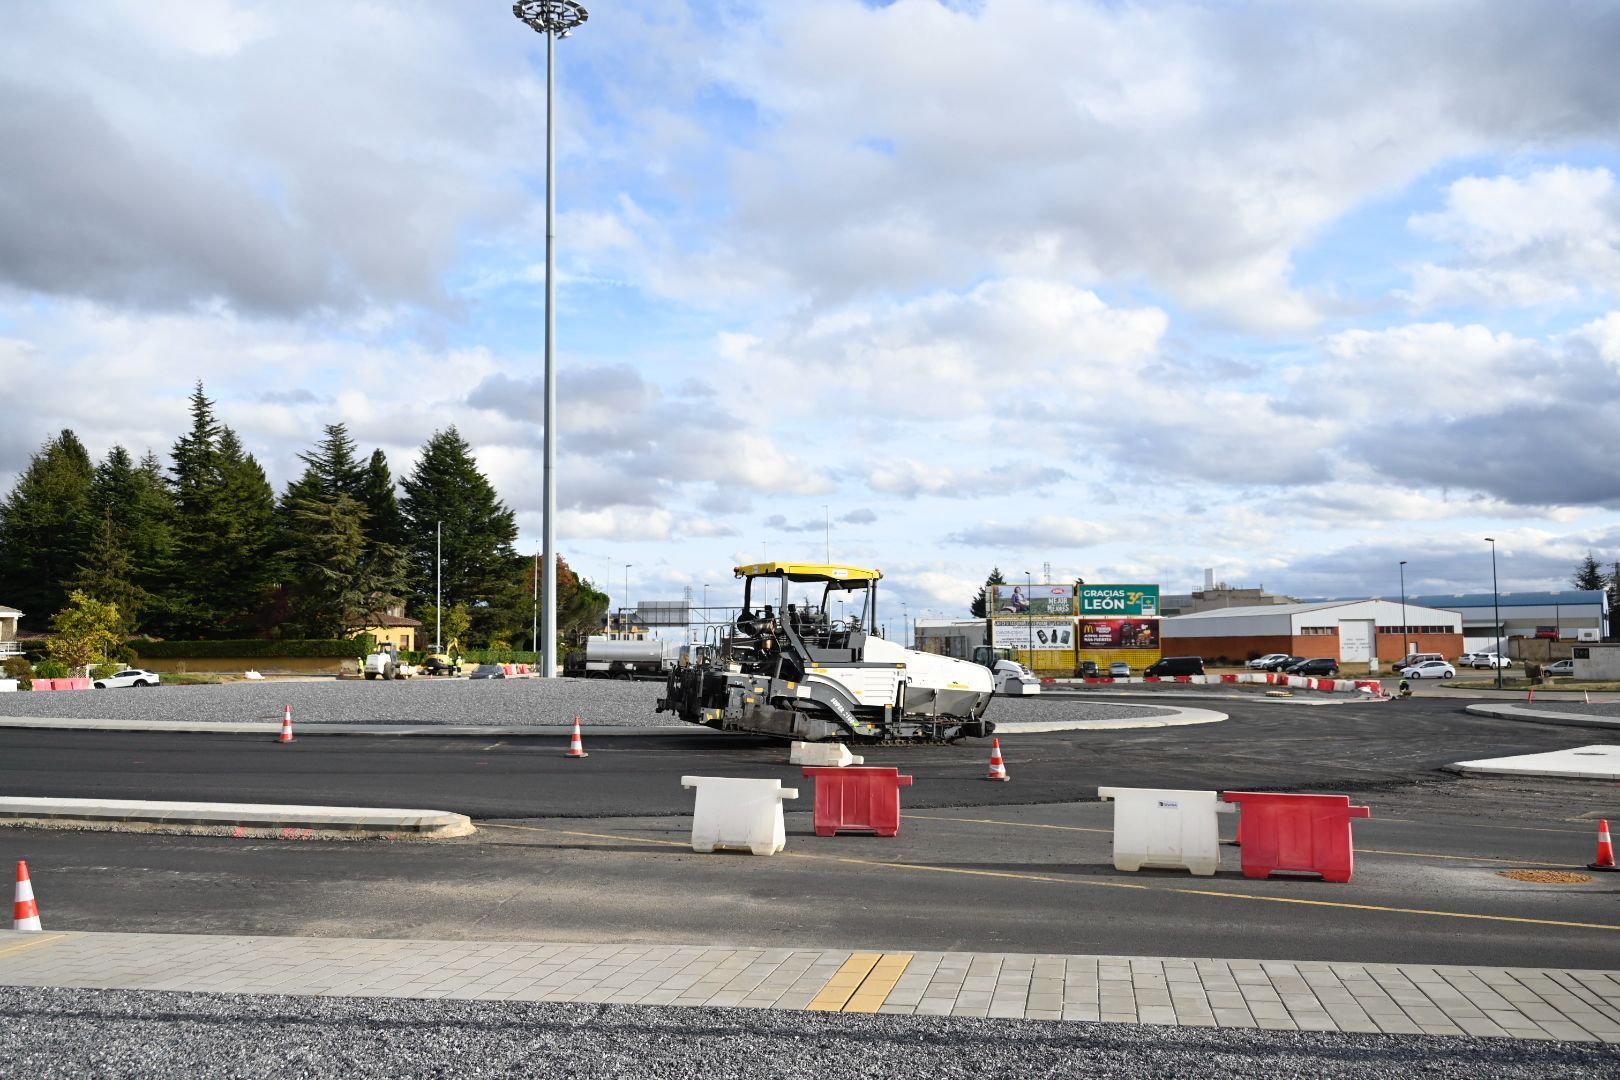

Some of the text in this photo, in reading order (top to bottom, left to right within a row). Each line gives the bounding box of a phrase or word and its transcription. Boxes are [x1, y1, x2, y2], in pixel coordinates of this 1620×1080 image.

[1083, 589, 1125, 597] GRACIAS
[1084, 596, 1125, 609] LEÓN
[830, 697, 845, 714] SUPER
